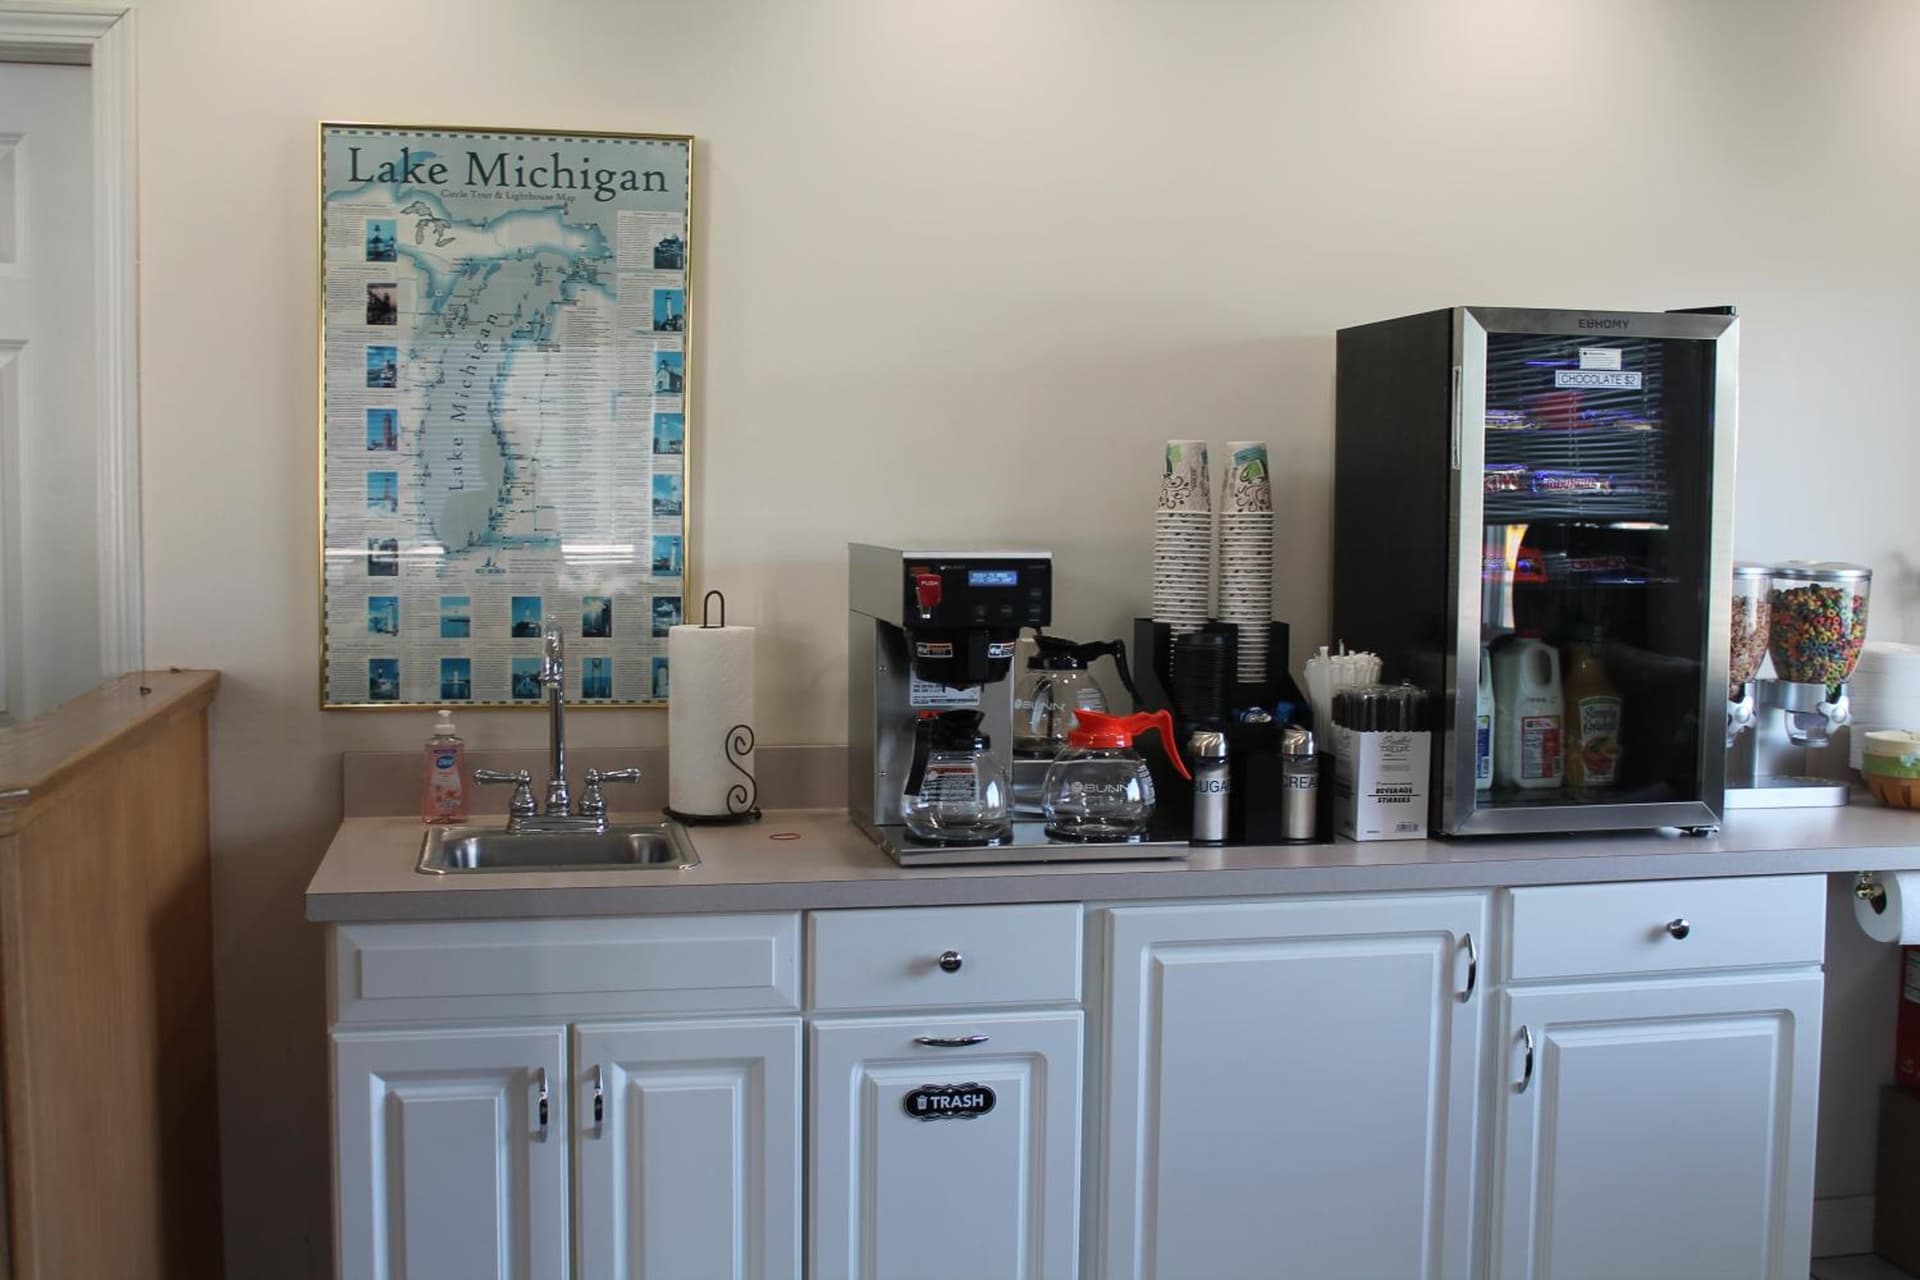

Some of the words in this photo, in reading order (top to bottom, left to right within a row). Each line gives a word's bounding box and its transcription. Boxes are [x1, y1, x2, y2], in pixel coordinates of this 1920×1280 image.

[348, 147, 449, 185] Lake
[465, 151, 669, 202] Michigan
[440, 189, 467, 199] Circle
[470, 190, 492, 200] Tour
[494, 191, 503, 200] &
[505, 191, 554, 202] Lighthouse
[556, 193, 577, 203] Map
[450, 313, 499, 423] Michigan
[1560, 374, 1623, 385] CHOCOLATE
[1624, 375, 1637, 385] $2
[447, 437, 465, 491] Lake
[1023, 700, 1066, 711] BUNN
[1083, 783, 1129, 793] BUNN
[1193, 779, 1231, 793] SUGA
[1282, 776, 1319, 790] CREA
[930, 1093, 984, 1109] TRASH
